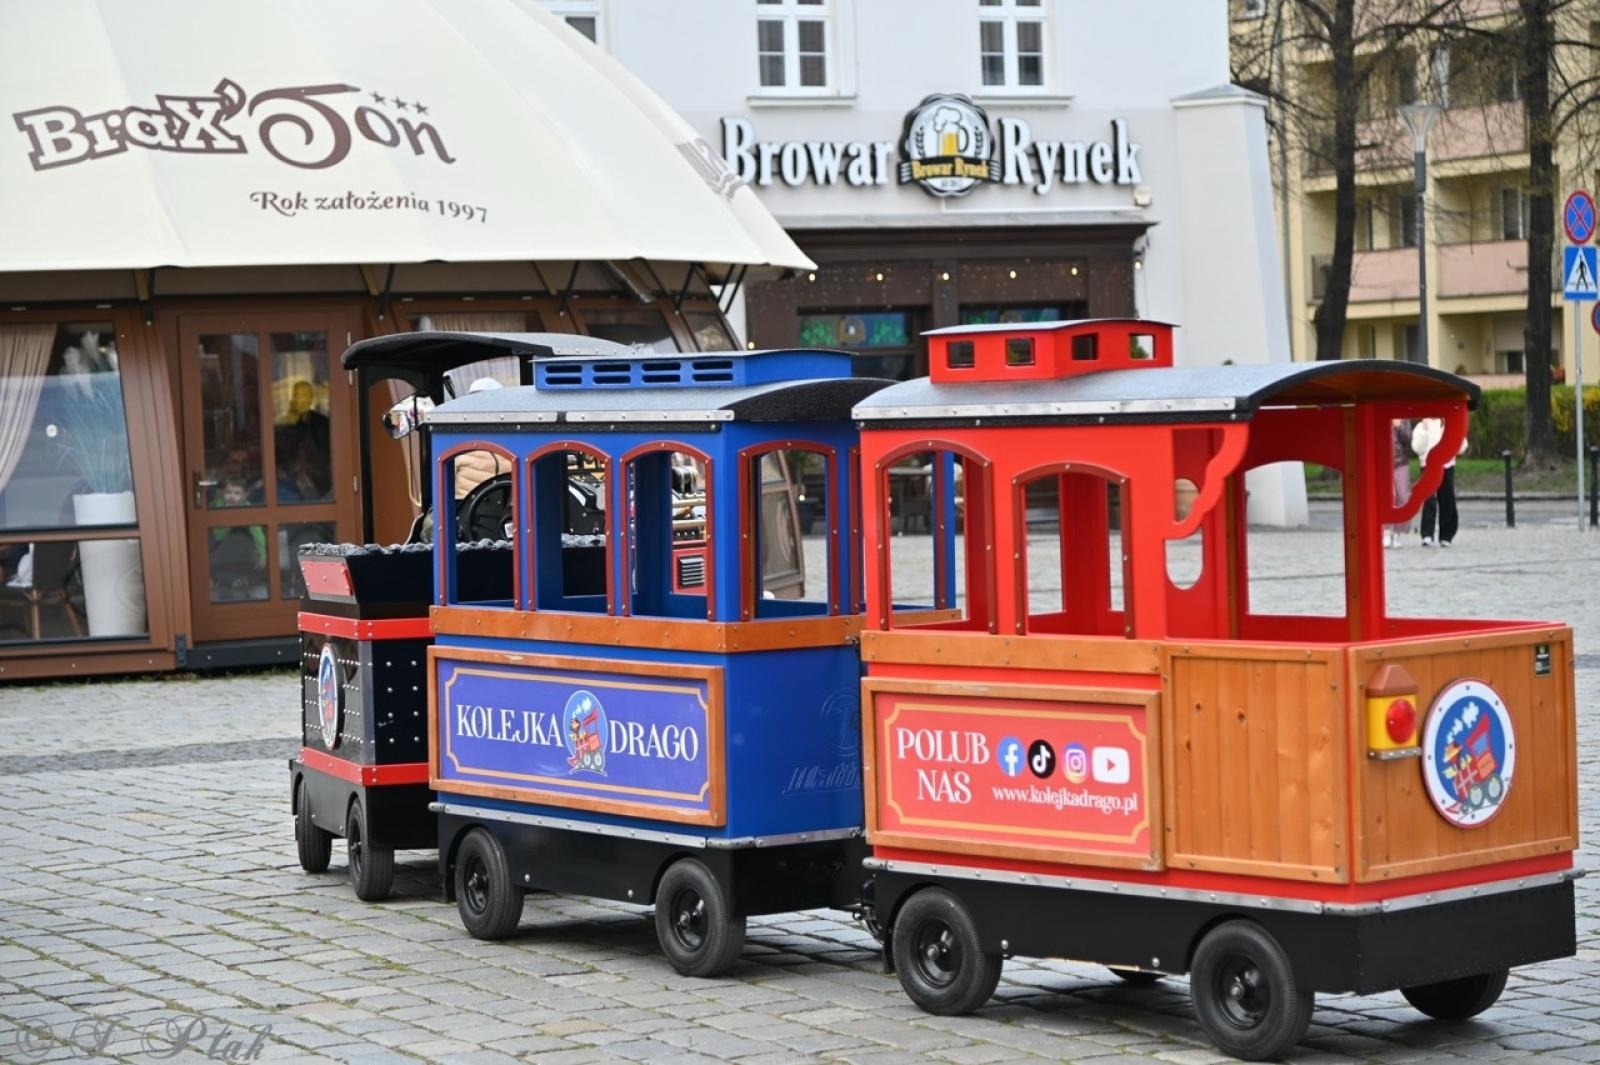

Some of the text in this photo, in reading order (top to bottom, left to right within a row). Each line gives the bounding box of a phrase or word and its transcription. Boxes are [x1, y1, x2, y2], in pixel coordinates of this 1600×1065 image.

[721, 117, 894, 187] Browar
[998, 117, 1143, 195] Rynek
[249, 190, 487, 223] Rok założenia 1997
[456, 703, 699, 762] KOLEJKA DRAGO
[896, 727, 990, 765] POLUB
[917, 769, 972, 804] NAS
[992, 785, 1138, 815] www.kolejkadrago.pl
